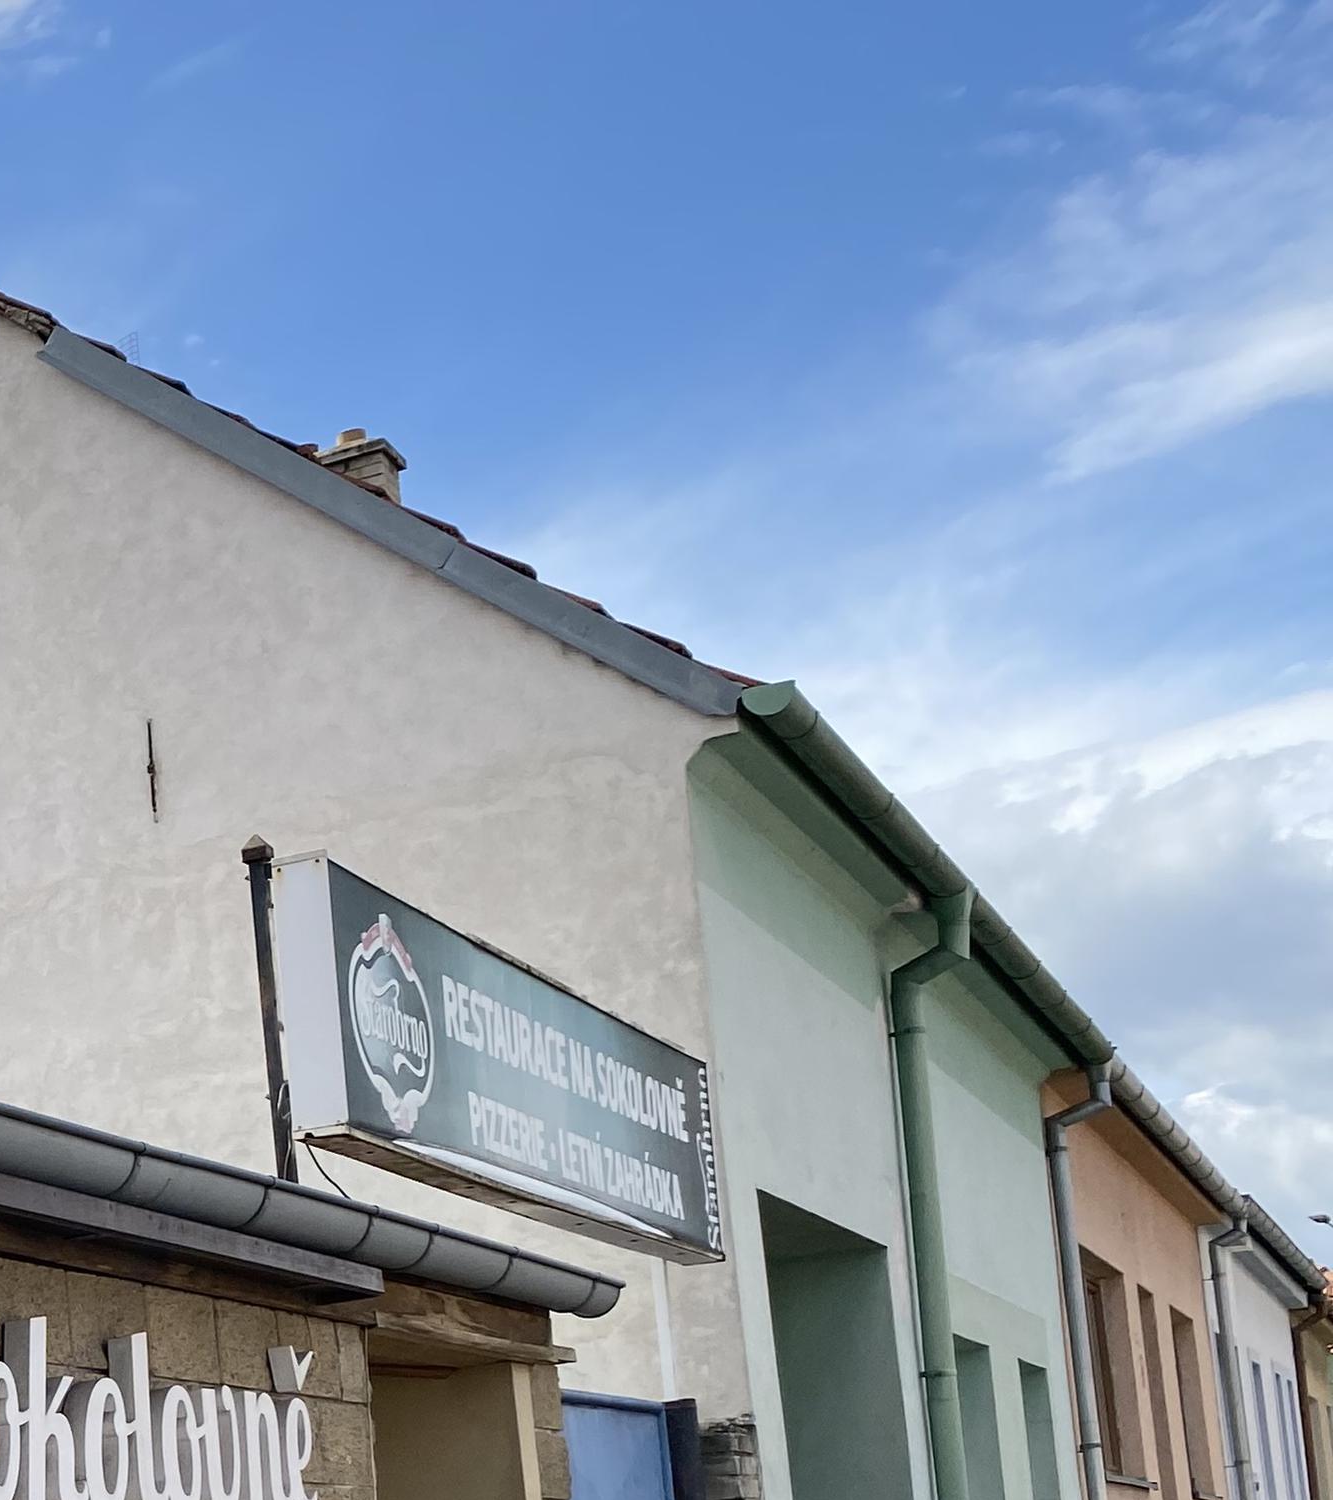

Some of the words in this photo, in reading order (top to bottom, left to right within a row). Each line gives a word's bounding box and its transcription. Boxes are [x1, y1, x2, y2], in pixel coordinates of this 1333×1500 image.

[442, 974, 570, 1090] RESTAURACE
[568, 1038, 598, 1103] NA
[596, 1051, 689, 1143] SOKOLOVNĚ
[468, 1090, 549, 1171] PIZZERIE
[558, 1128, 606, 1193] LETNÍ
[604, 1146, 685, 1221] ZAHRÁDKA
